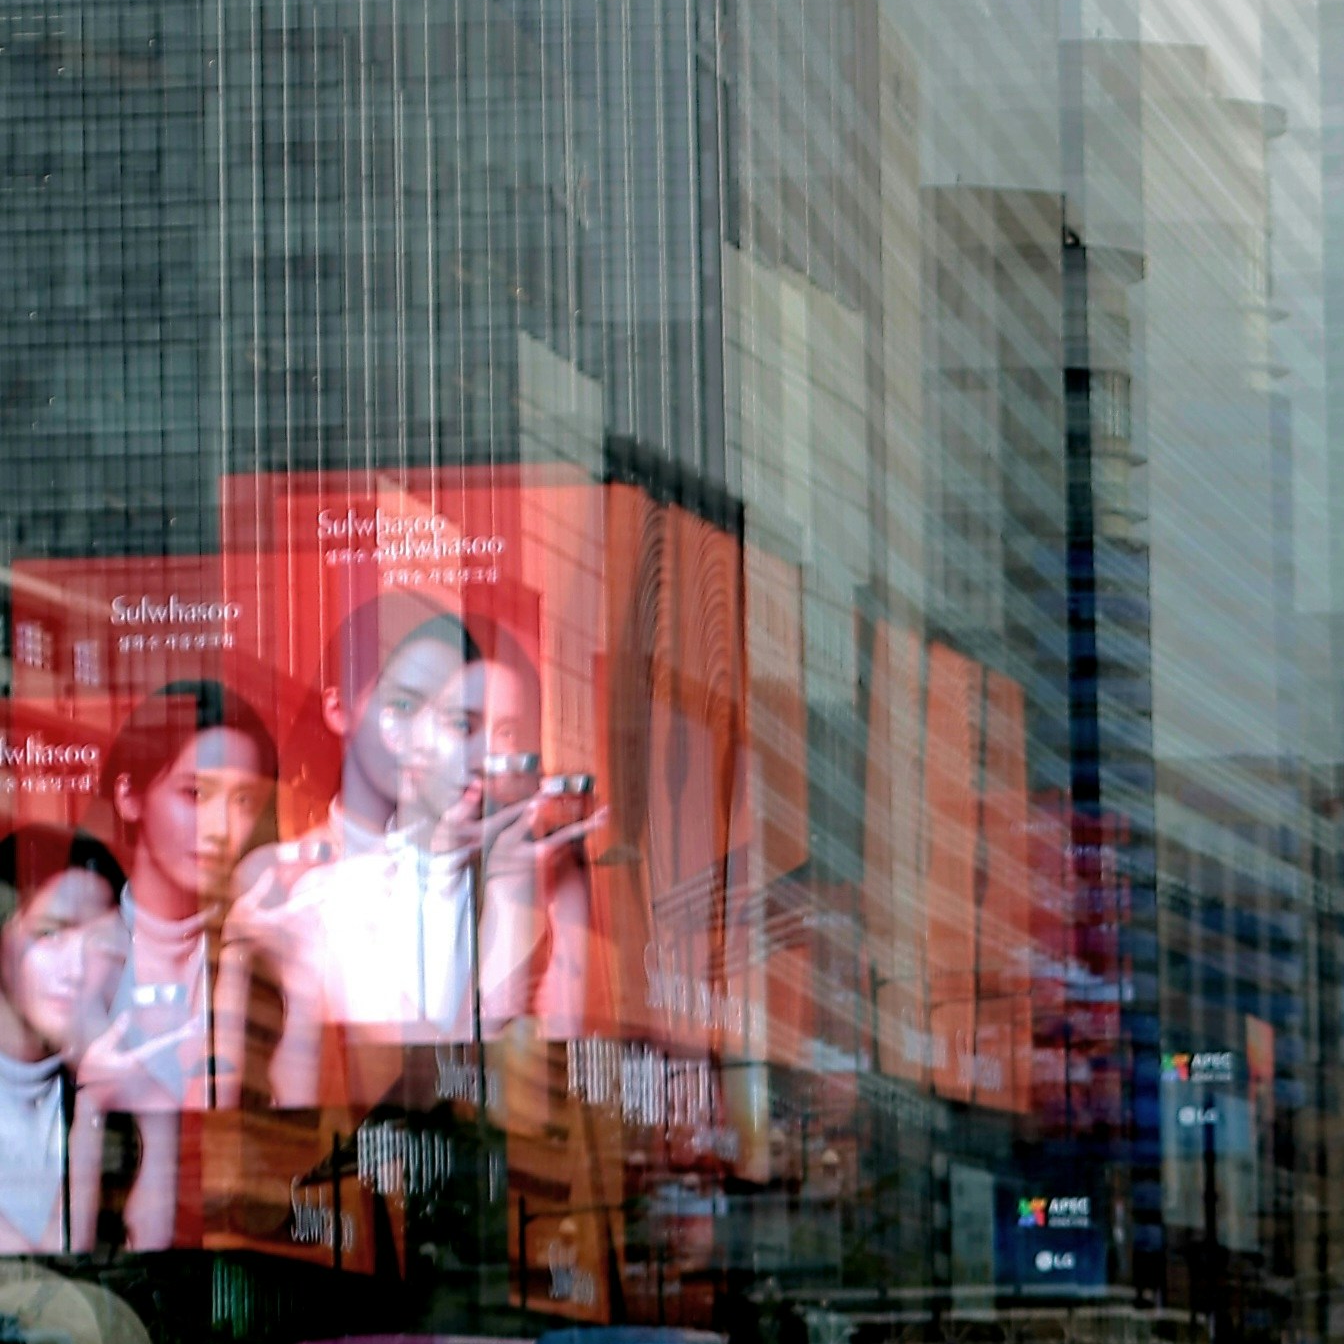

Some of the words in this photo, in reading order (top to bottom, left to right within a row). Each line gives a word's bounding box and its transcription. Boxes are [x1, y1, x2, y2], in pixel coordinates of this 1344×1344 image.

[317, 508, 445, 539] Sulwhasoo
[110, 594, 240, 625] Sulwhasoo
[1048, 1197, 1090, 1215] APEC
